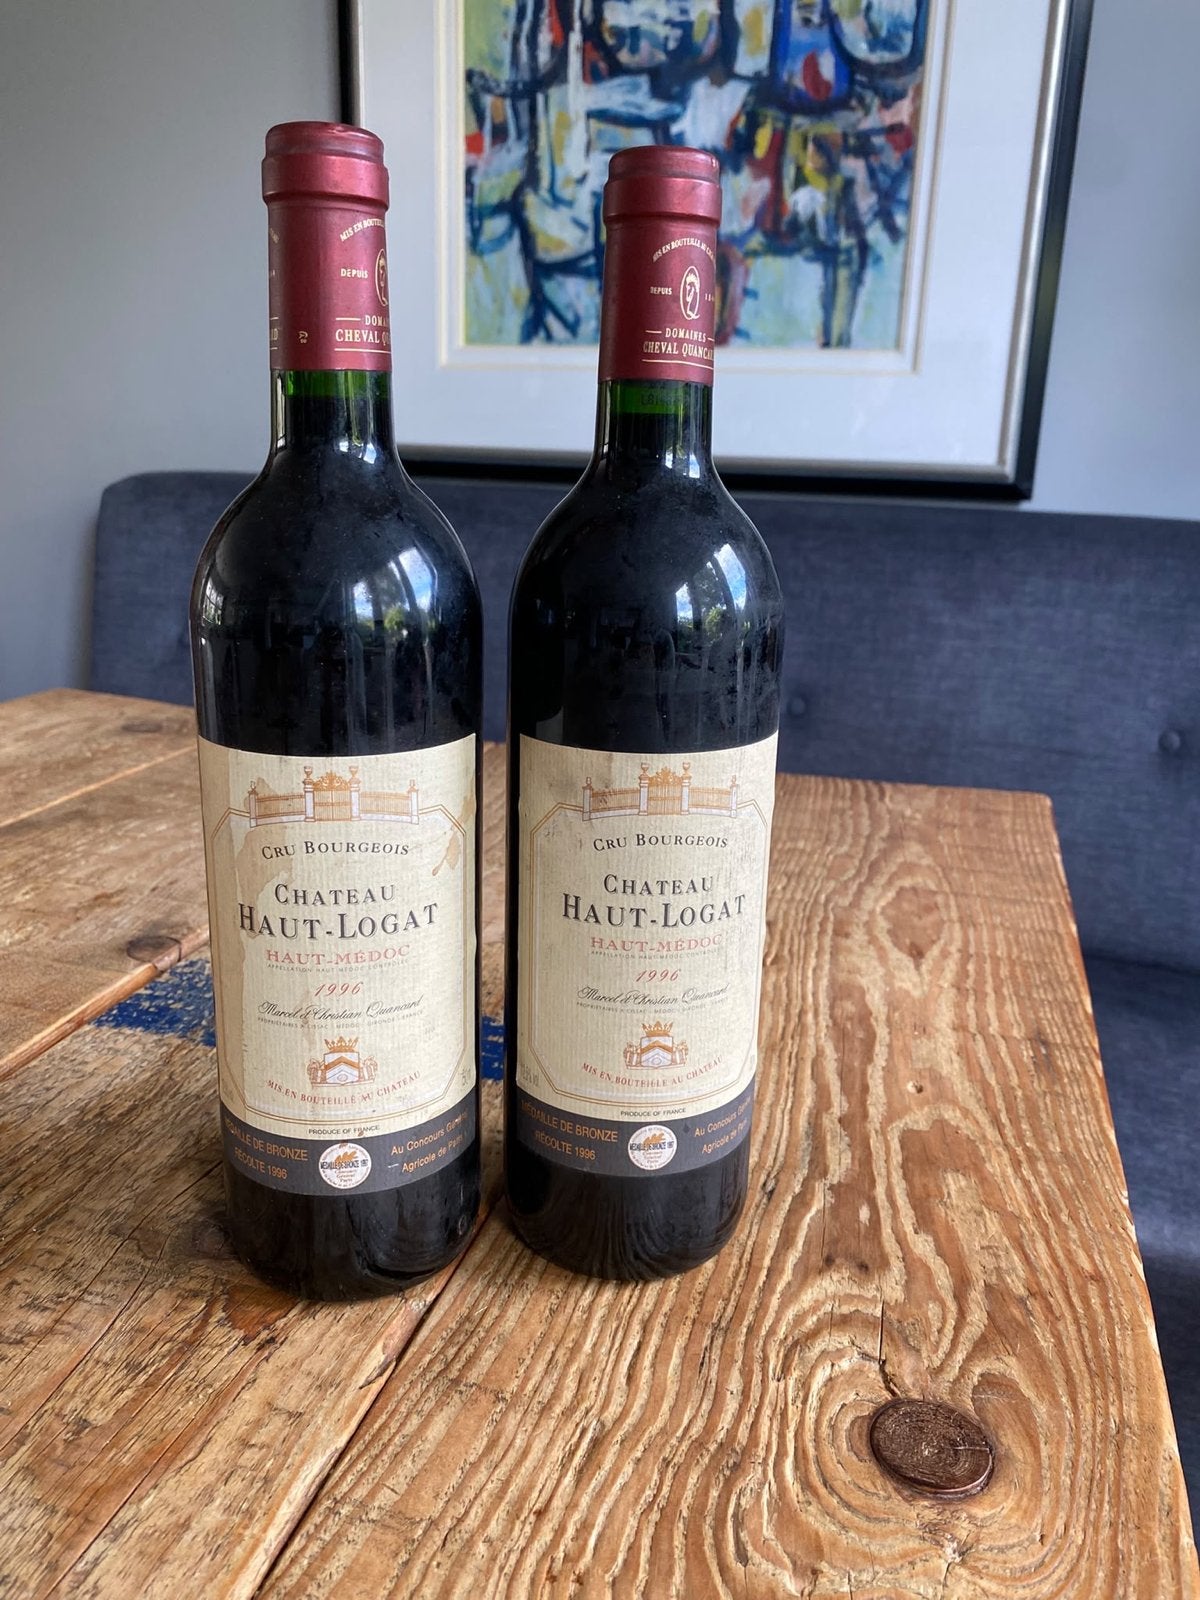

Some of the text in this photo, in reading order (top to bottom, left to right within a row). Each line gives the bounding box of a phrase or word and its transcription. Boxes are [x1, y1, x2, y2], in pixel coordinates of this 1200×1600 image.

[340, 227, 354, 241] MIS
[340, 268, 369, 279] DEPUIS
[650, 286, 673, 296] DEPUIS
[335, 328, 380, 344] CHEVAL
[665, 327, 707, 343] DOMAINES
[642, 341, 679, 355] CHEVAL
[593, 833, 729, 851] CRU BOURGEOIS
[262, 841, 410, 860] CRU BOURGEOIS
[603, 873, 714, 896] CHATEAU
[274, 883, 396, 906] CHATEAU
[562, 892, 746, 929] HAUT-LOGAT
[238, 902, 439, 941] HAUT-LOGAT
[635, 968, 682, 983] 1996
[314, 981, 364, 997] 1996
[577, 986, 624, 1002] Marcel
[258, 1001, 302, 1018] Marcel
[582, 1062, 598, 1075] MIS
[600, 1071, 611, 1081] EN
[615, 1076, 669, 1088] BOUTEILLE
[672, 1075, 684, 1085] AU
[267, 1072, 421, 1106] MIS EN BOUTEILLE AU CHATEAU
[663, 1107, 687, 1116] FRANCE
[353, 1125, 381, 1134] FRANCE
[560, 1120, 573, 1134] DE
[575, 1124, 618, 1142] BRONZE
[694, 1127, 706, 1138] Au
[252, 1136, 265, 1152] DE
[266, 1142, 309, 1161] BRONZE
[391, 1144, 404, 1156] Au
[406, 1128, 445, 1151] Concours
[701, 1133, 729, 1154] Agricole
[401, 1151, 436, 1174] Agricole
[437, 1146, 447, 1158] de
[574, 1146, 596, 1160] 1996
[267, 1164, 288, 1180] 1996
